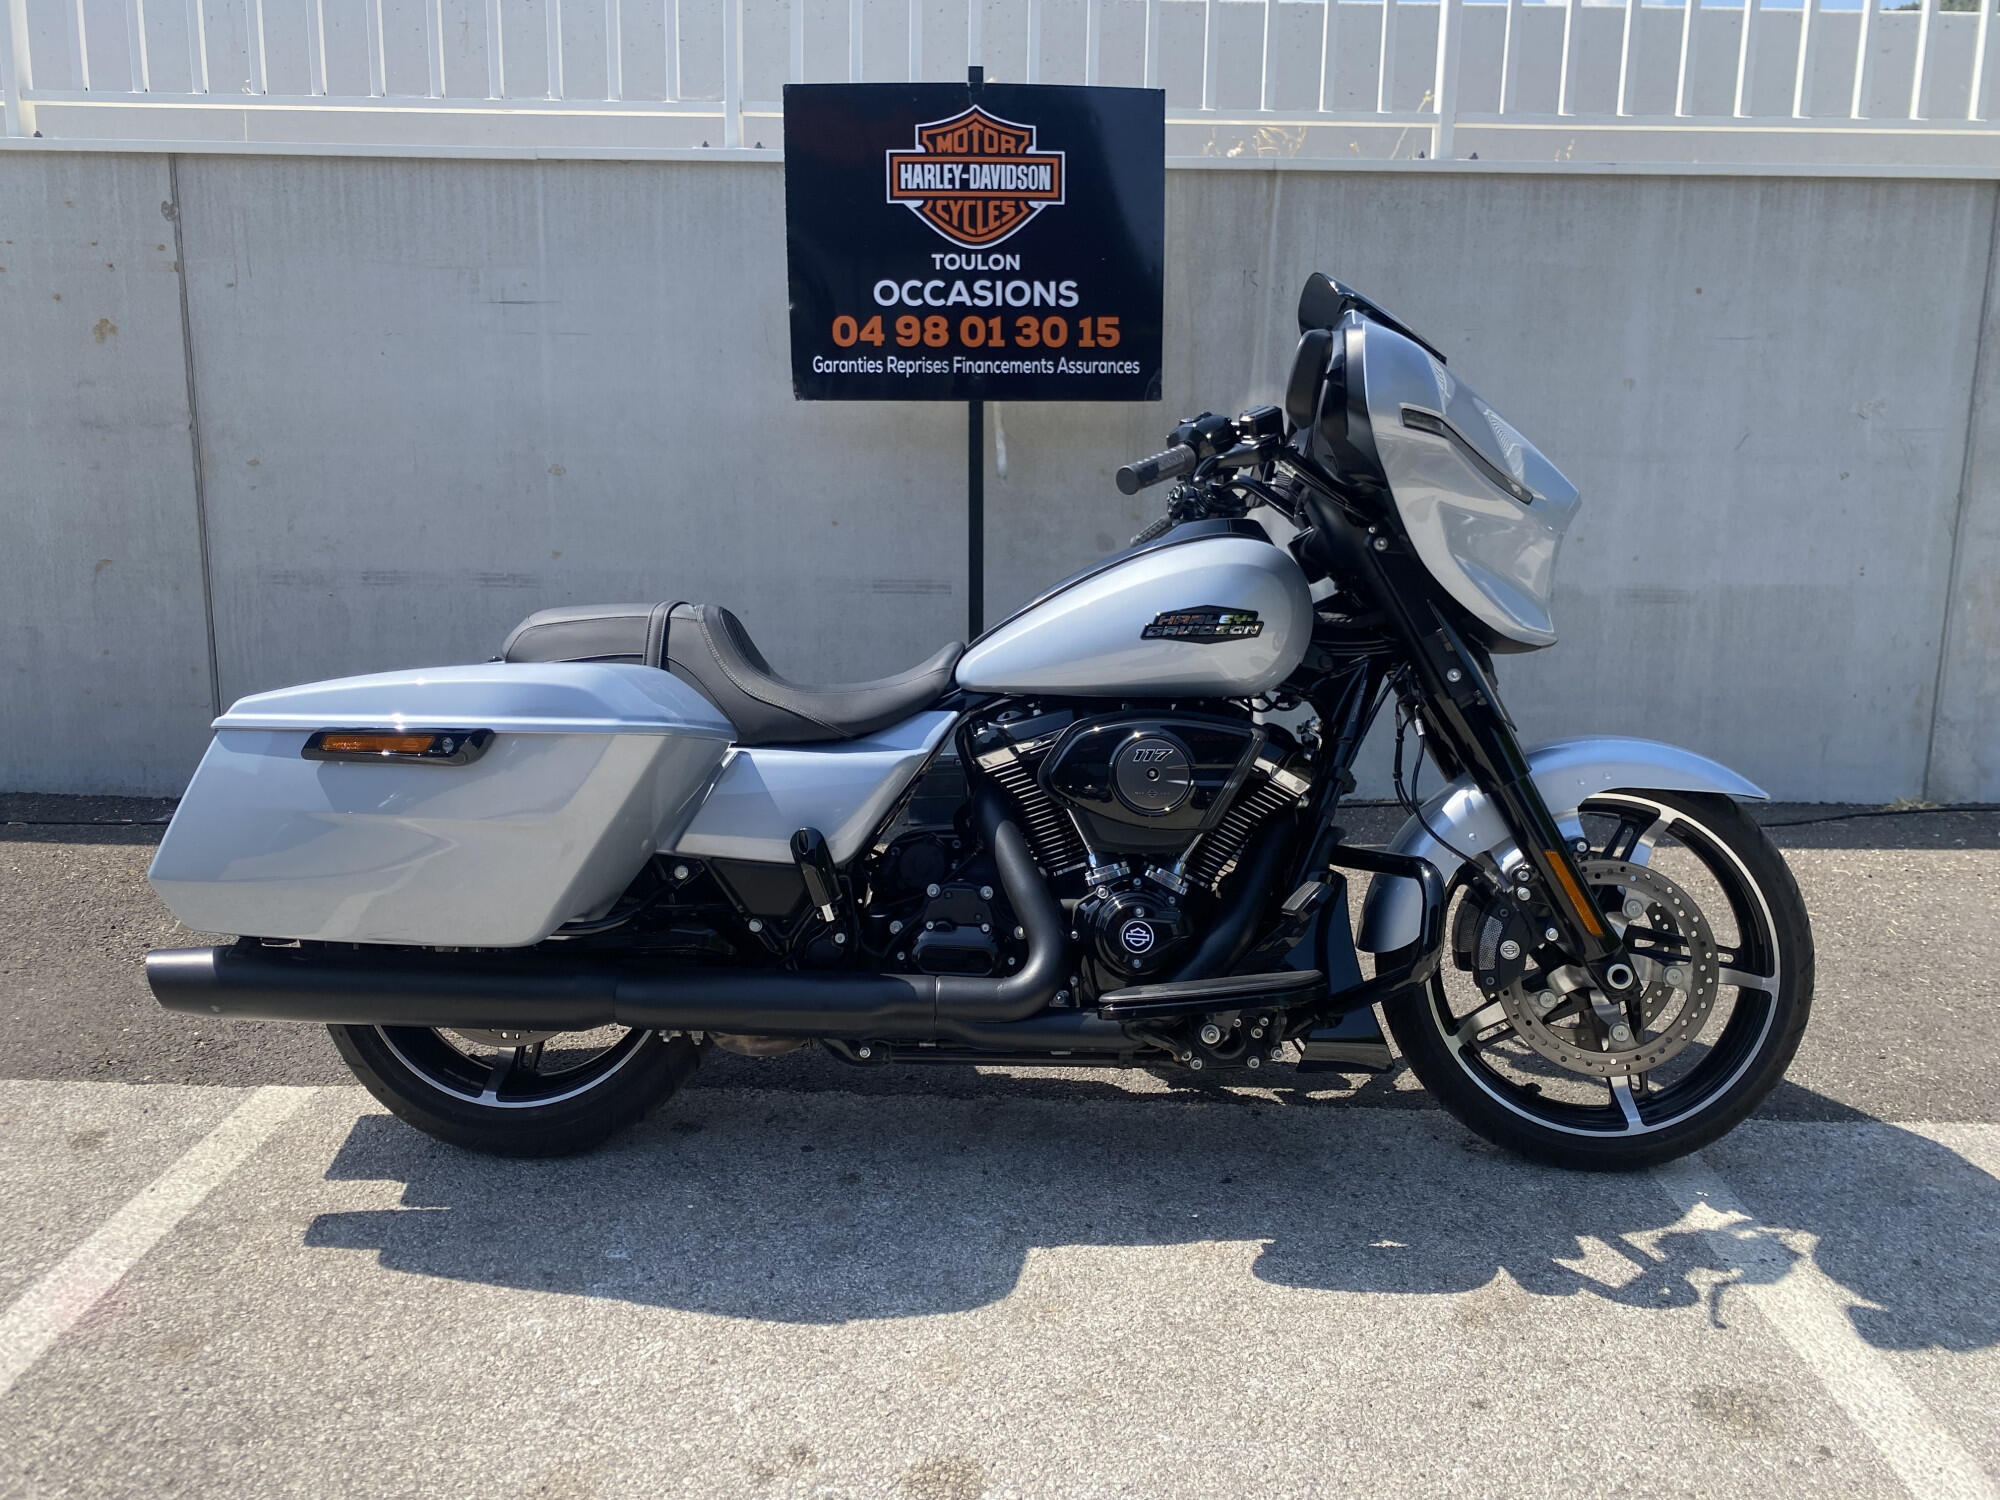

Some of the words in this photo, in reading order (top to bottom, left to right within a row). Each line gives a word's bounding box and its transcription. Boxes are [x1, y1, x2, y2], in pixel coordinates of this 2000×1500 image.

[936, 122, 1017, 154] MOTOR
[900, 163, 1052, 190] HARLEY-DAVIDSON
[936, 200, 1016, 235] CYCLES
[931, 253, 1020, 271] TOULON
[873, 279, 1079, 308] OCCASIONS
[832, 315, 885, 347] 04
[895, 315, 949, 347] 98
[959, 315, 1006, 348] 01
[1015, 316, 1068, 348] 30
[1078, 316, 1121, 348] 15
[812, 355, 884, 374] Garanties
[887, 355, 950, 378] Reprises
[953, 356, 1054, 374] Financements
[1057, 356, 1140, 375] Assurances
[1132, 748, 1174, 762] 117
